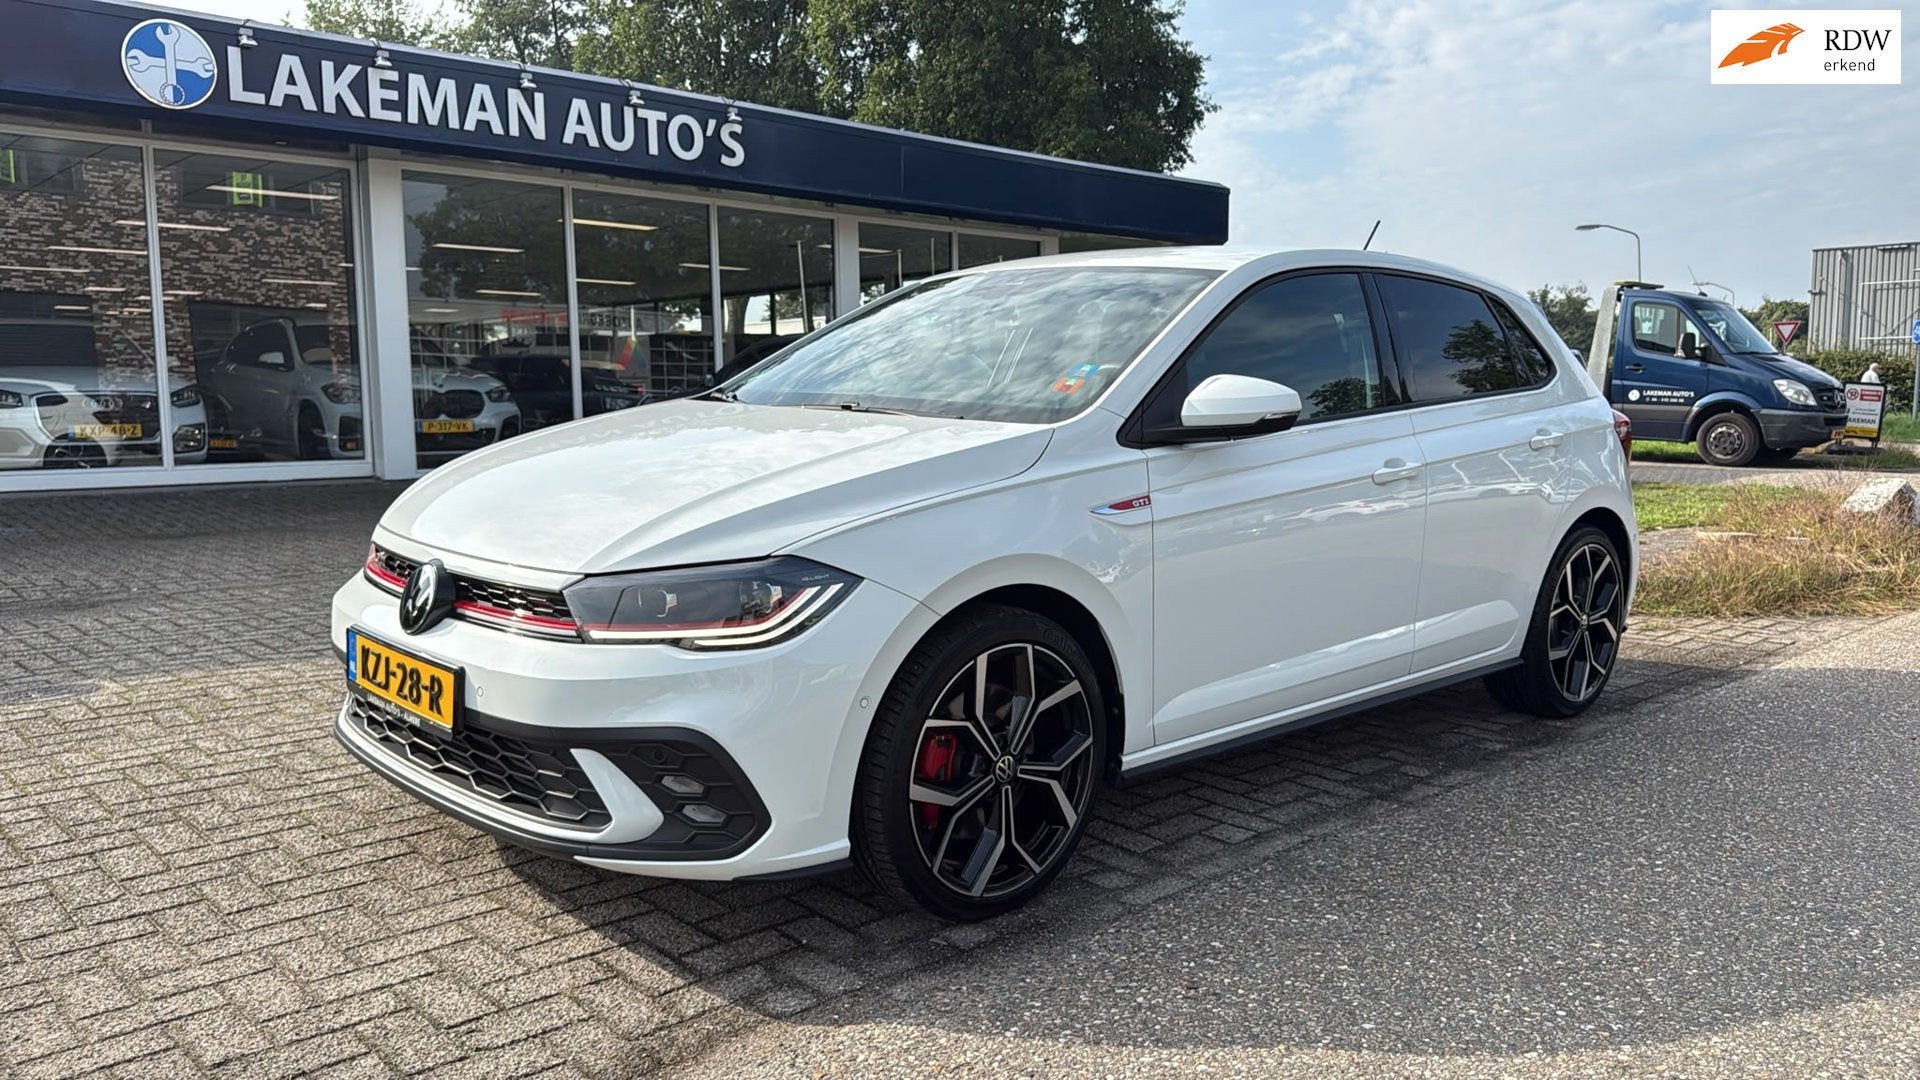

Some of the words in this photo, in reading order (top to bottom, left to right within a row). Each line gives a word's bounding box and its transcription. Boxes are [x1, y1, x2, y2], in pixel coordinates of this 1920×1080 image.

[226, 46, 546, 141] LAKEMAN
[562, 98, 746, 168] AUTO'S
[1132, 498, 1149, 507] GTI
[361, 645, 444, 718] KZJ-28-R
